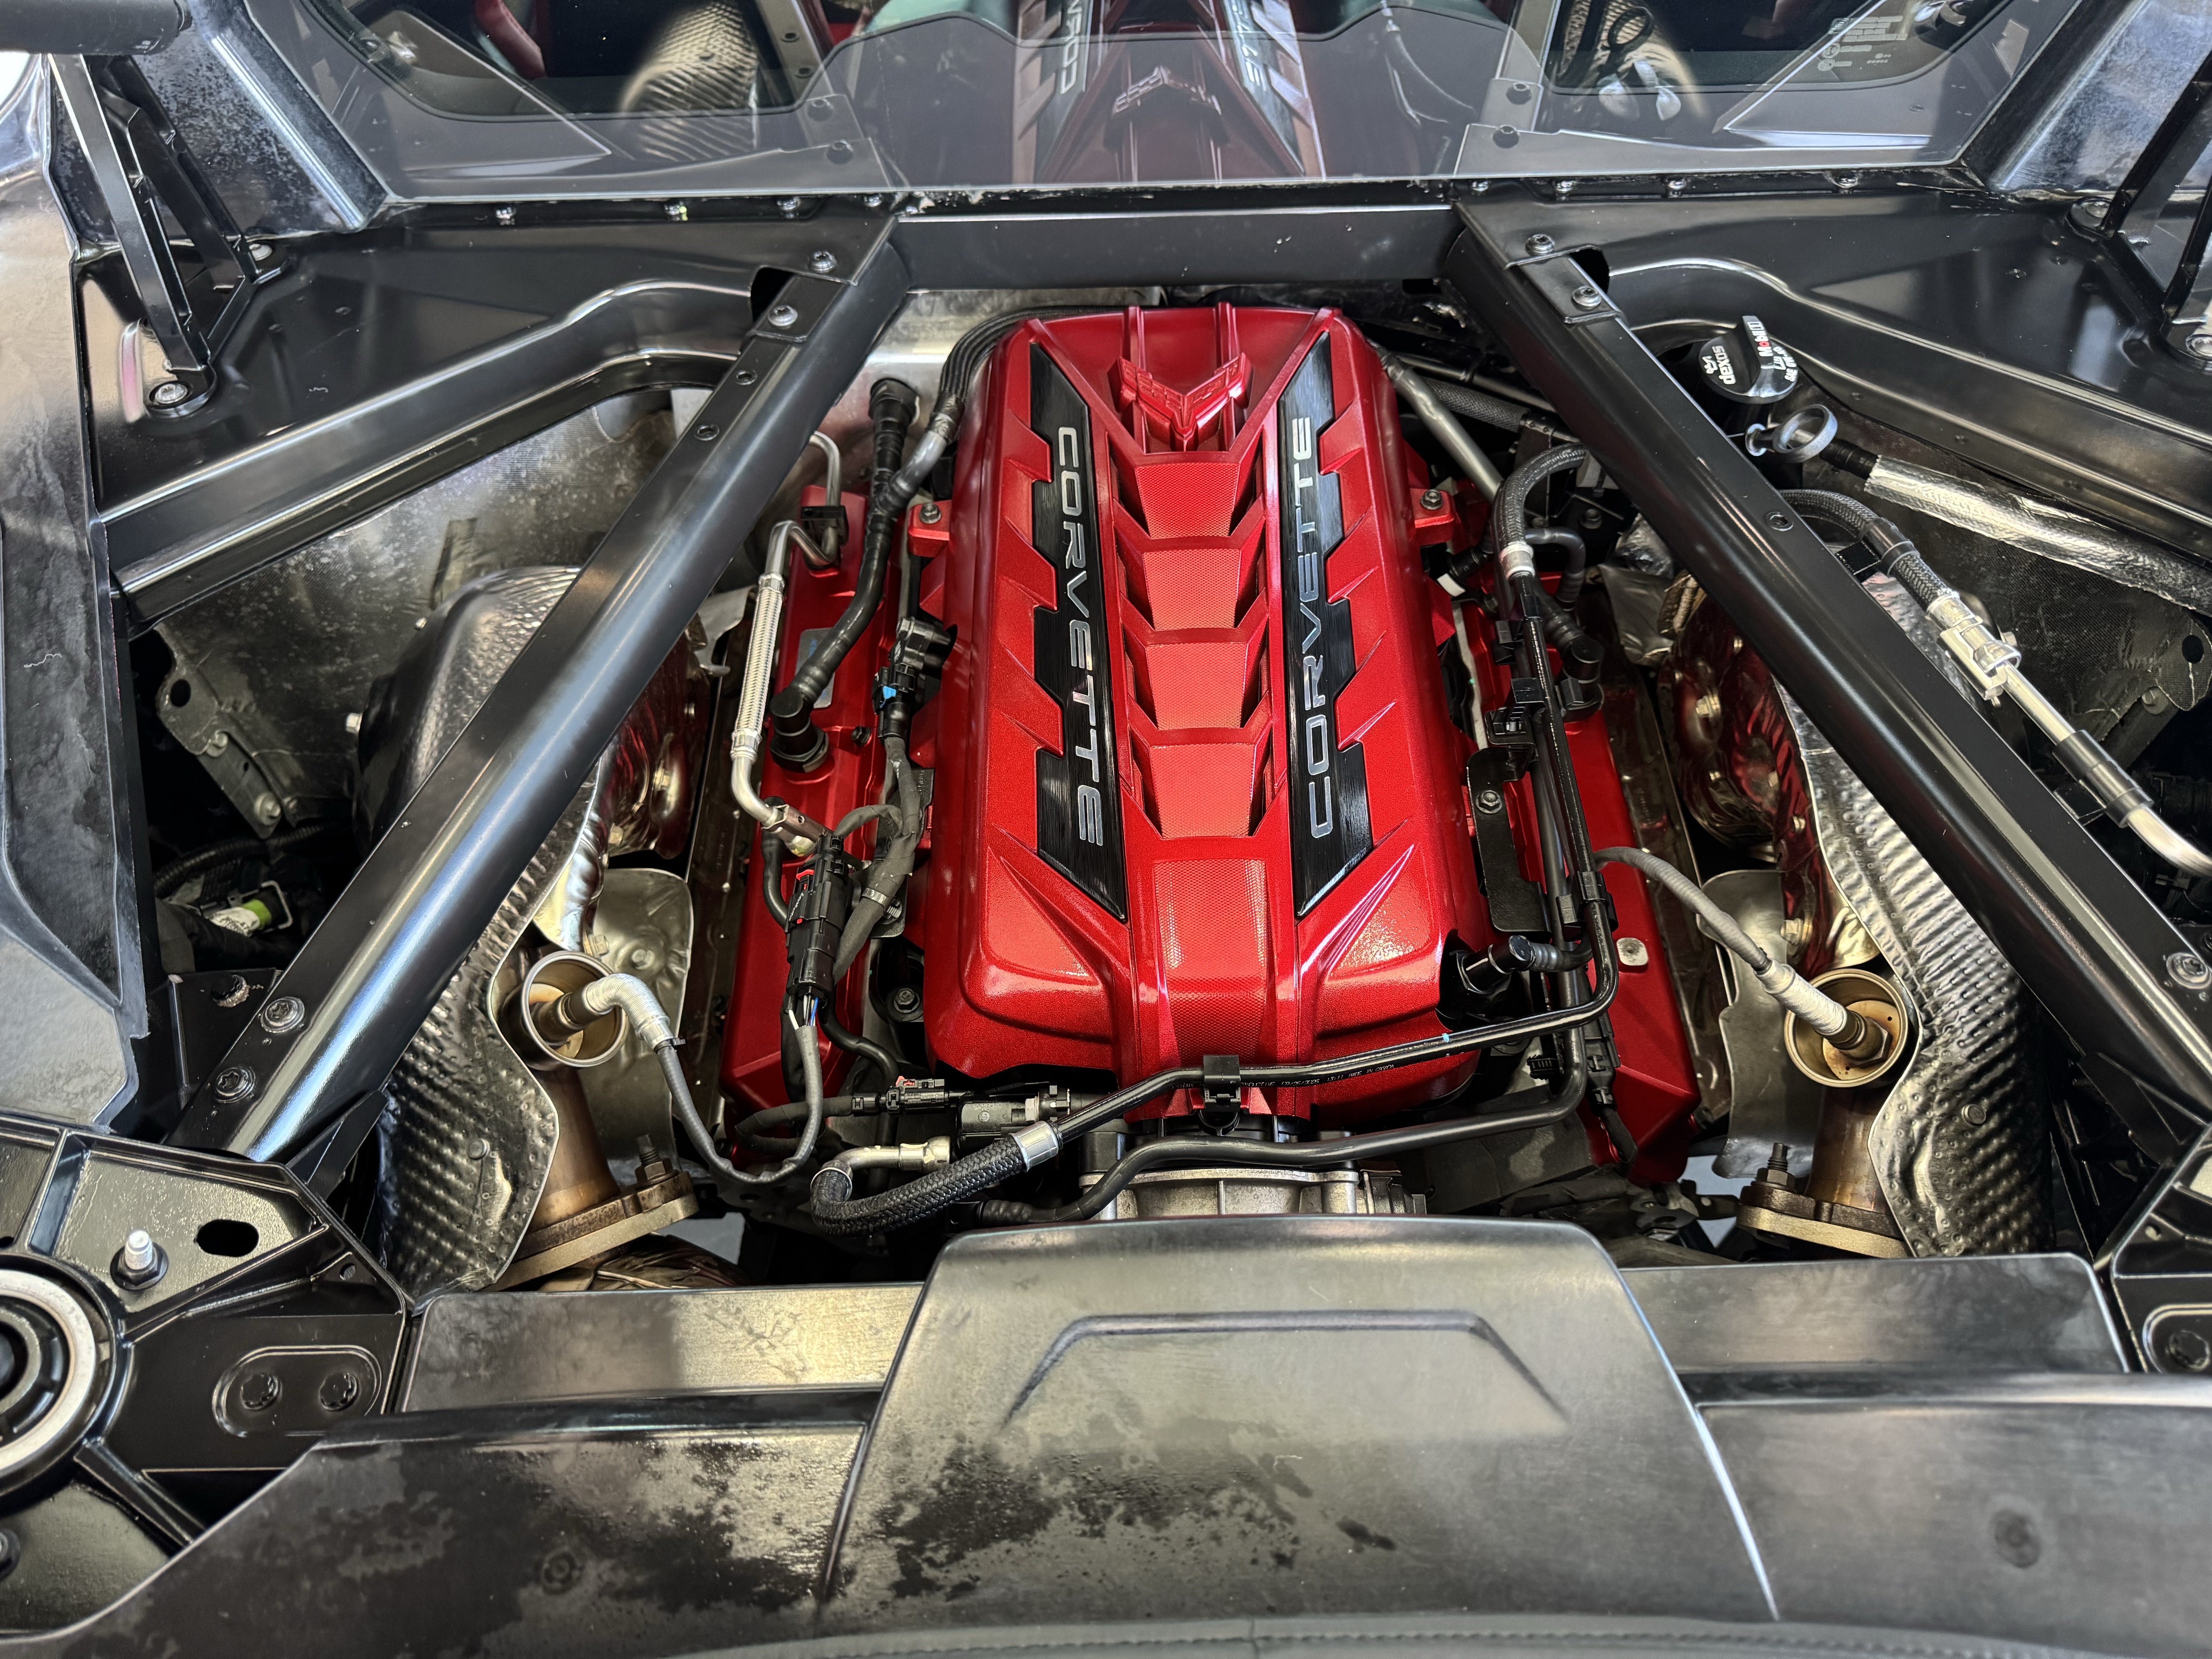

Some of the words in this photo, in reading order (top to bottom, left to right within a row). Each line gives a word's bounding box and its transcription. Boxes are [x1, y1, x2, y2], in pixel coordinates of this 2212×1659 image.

[1747, 321, 1765, 330] 1
[1751, 330, 1774, 357] Mobil
[1712, 345, 1736, 385] dexos
[1784, 368, 1798, 382] SAE
[1058, 427, 1103, 847] CORVETTE
[1292, 417, 1333, 838] CORVETTE
